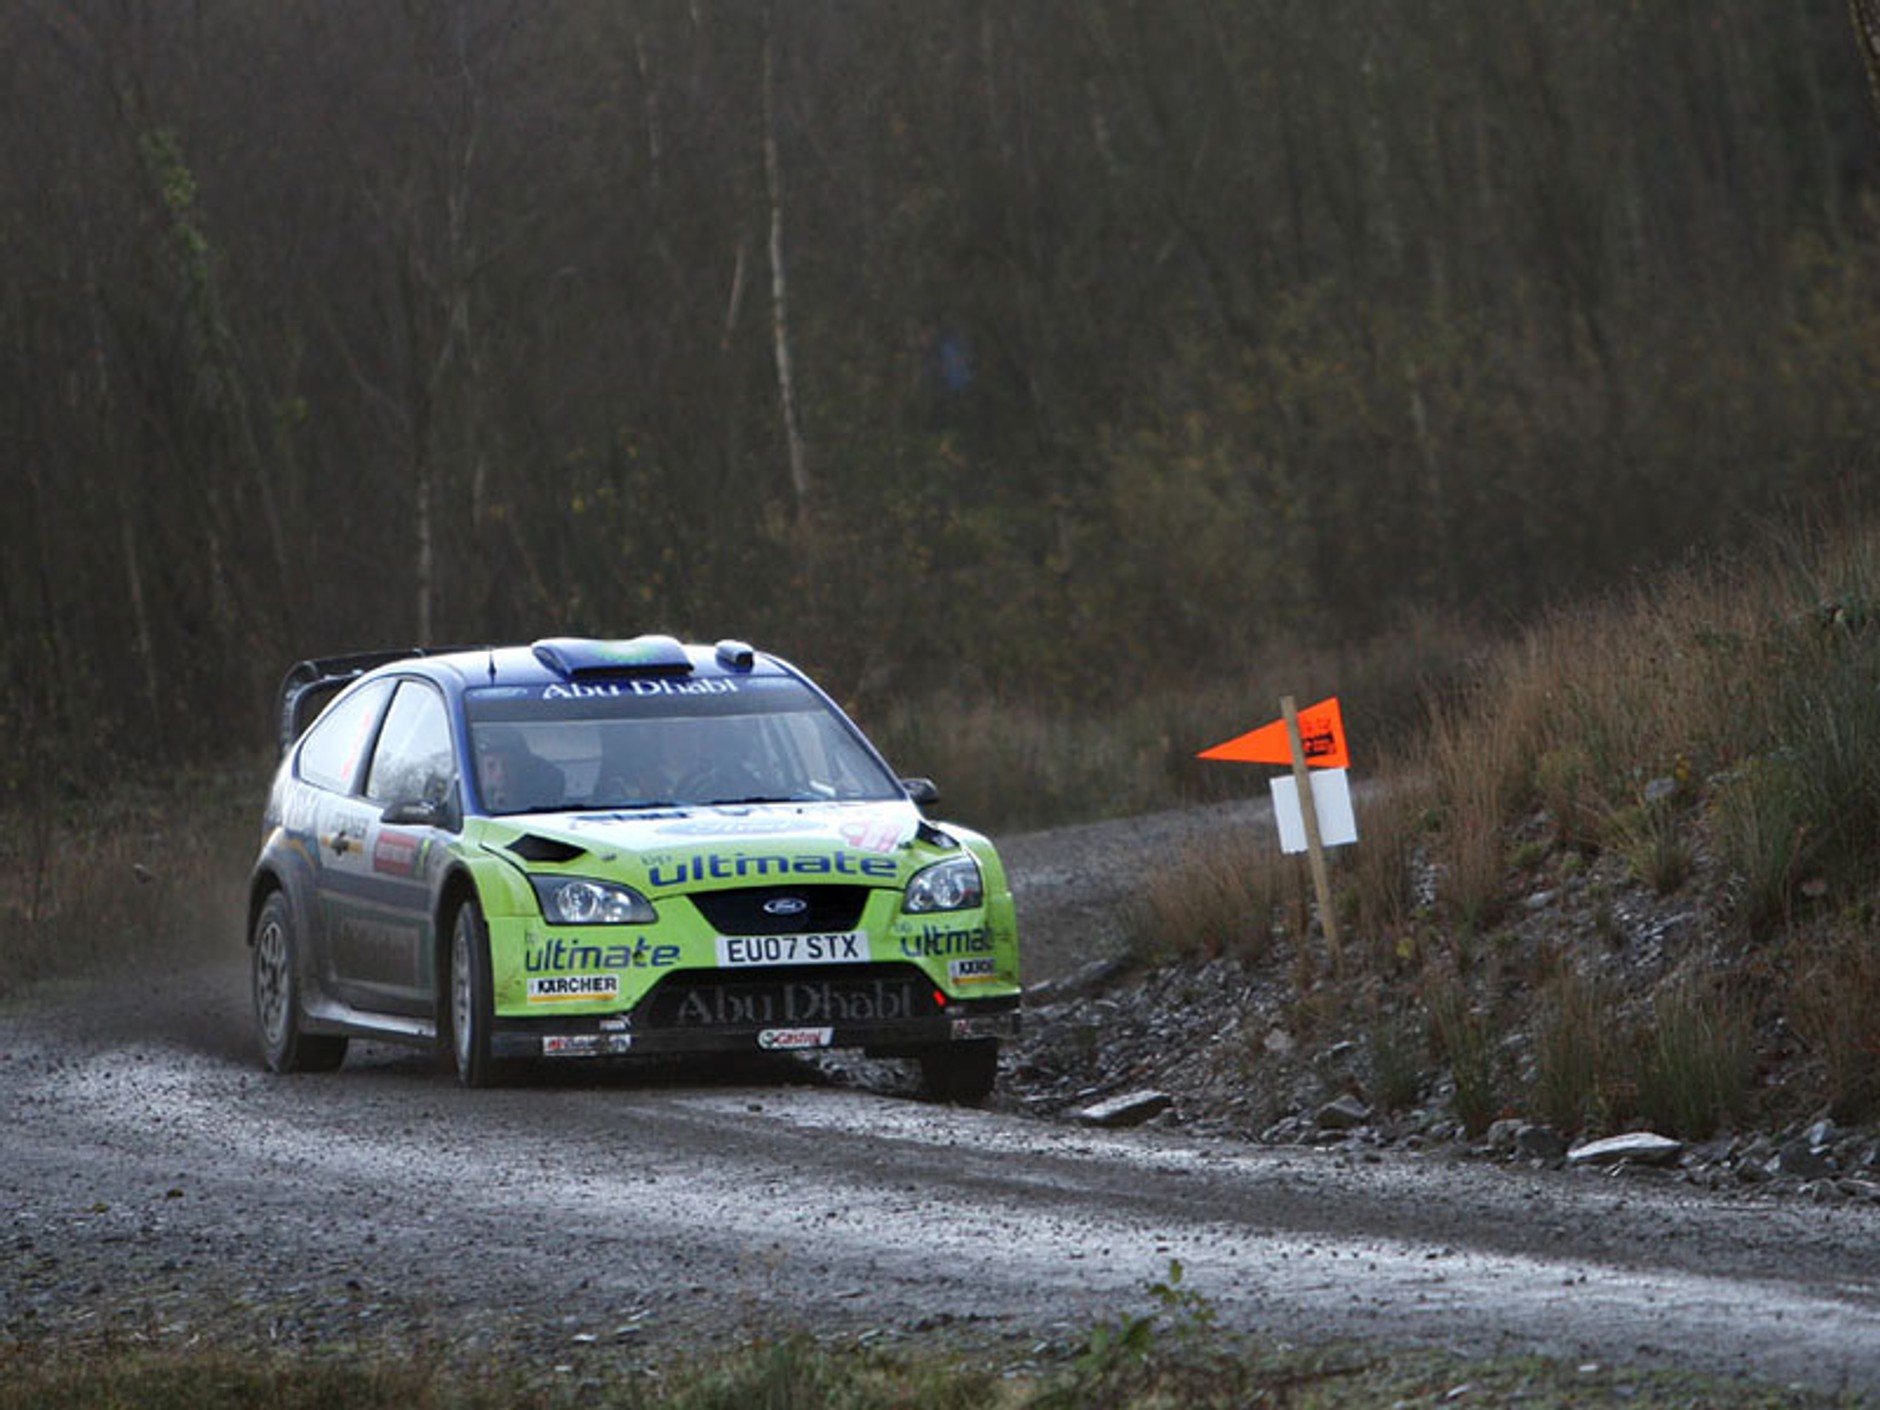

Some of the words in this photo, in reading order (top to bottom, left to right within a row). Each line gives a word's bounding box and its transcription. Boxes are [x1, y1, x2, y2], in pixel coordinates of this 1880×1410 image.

[542, 682, 620, 700] Abu
[649, 851, 898, 887] ultimate
[525, 935, 682, 972] ultimate
[727, 937, 798, 962] EU07
[807, 935, 859, 960] STX
[678, 981, 773, 1024] Abu
